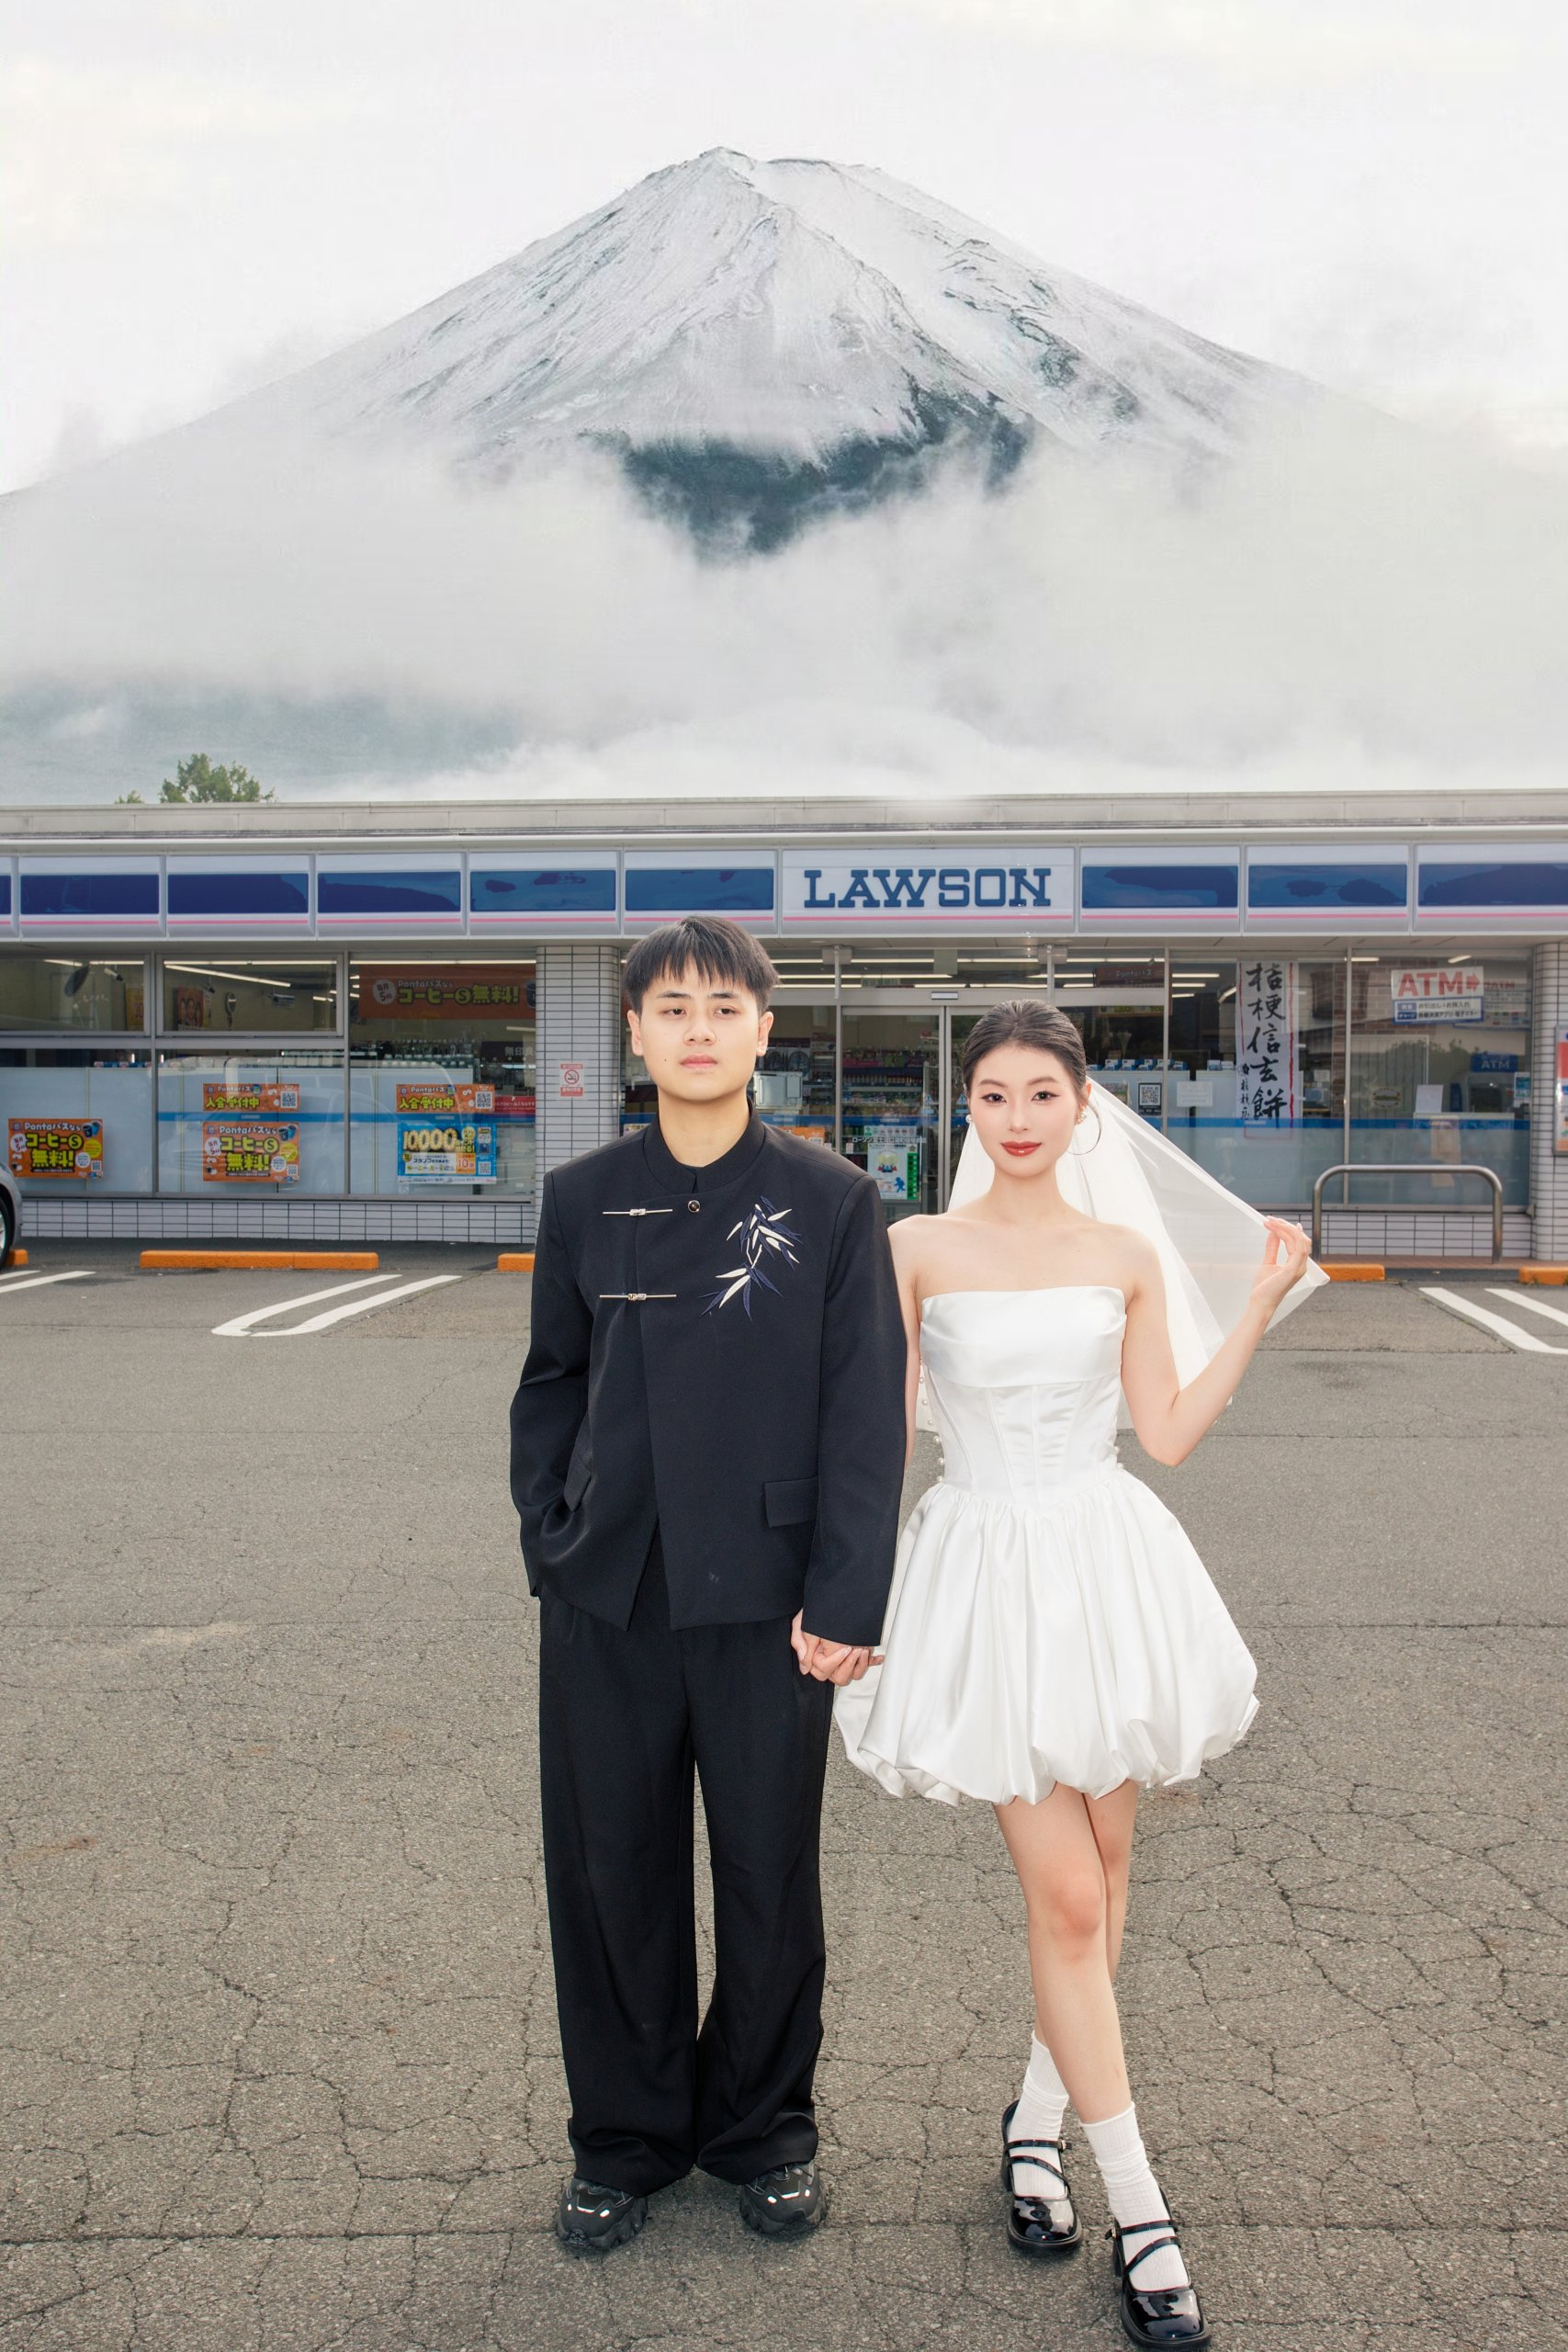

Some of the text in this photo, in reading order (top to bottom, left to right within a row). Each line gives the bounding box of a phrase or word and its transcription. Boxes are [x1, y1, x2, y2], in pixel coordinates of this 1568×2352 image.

[804, 868, 1051, 908] LAWSON
[1397, 971, 1463, 997] ATM
[1246, 962, 1287, 1129] 桔梗信玄餅
[1481, 1060, 1510, 1069] ATM
[206, 1095, 260, 1109] 入会受付中
[399, 1096, 455, 1110] 入会受付中
[31, 1149, 74, 1167] 無料!
[226, 1152, 270, 1171] 無料!
